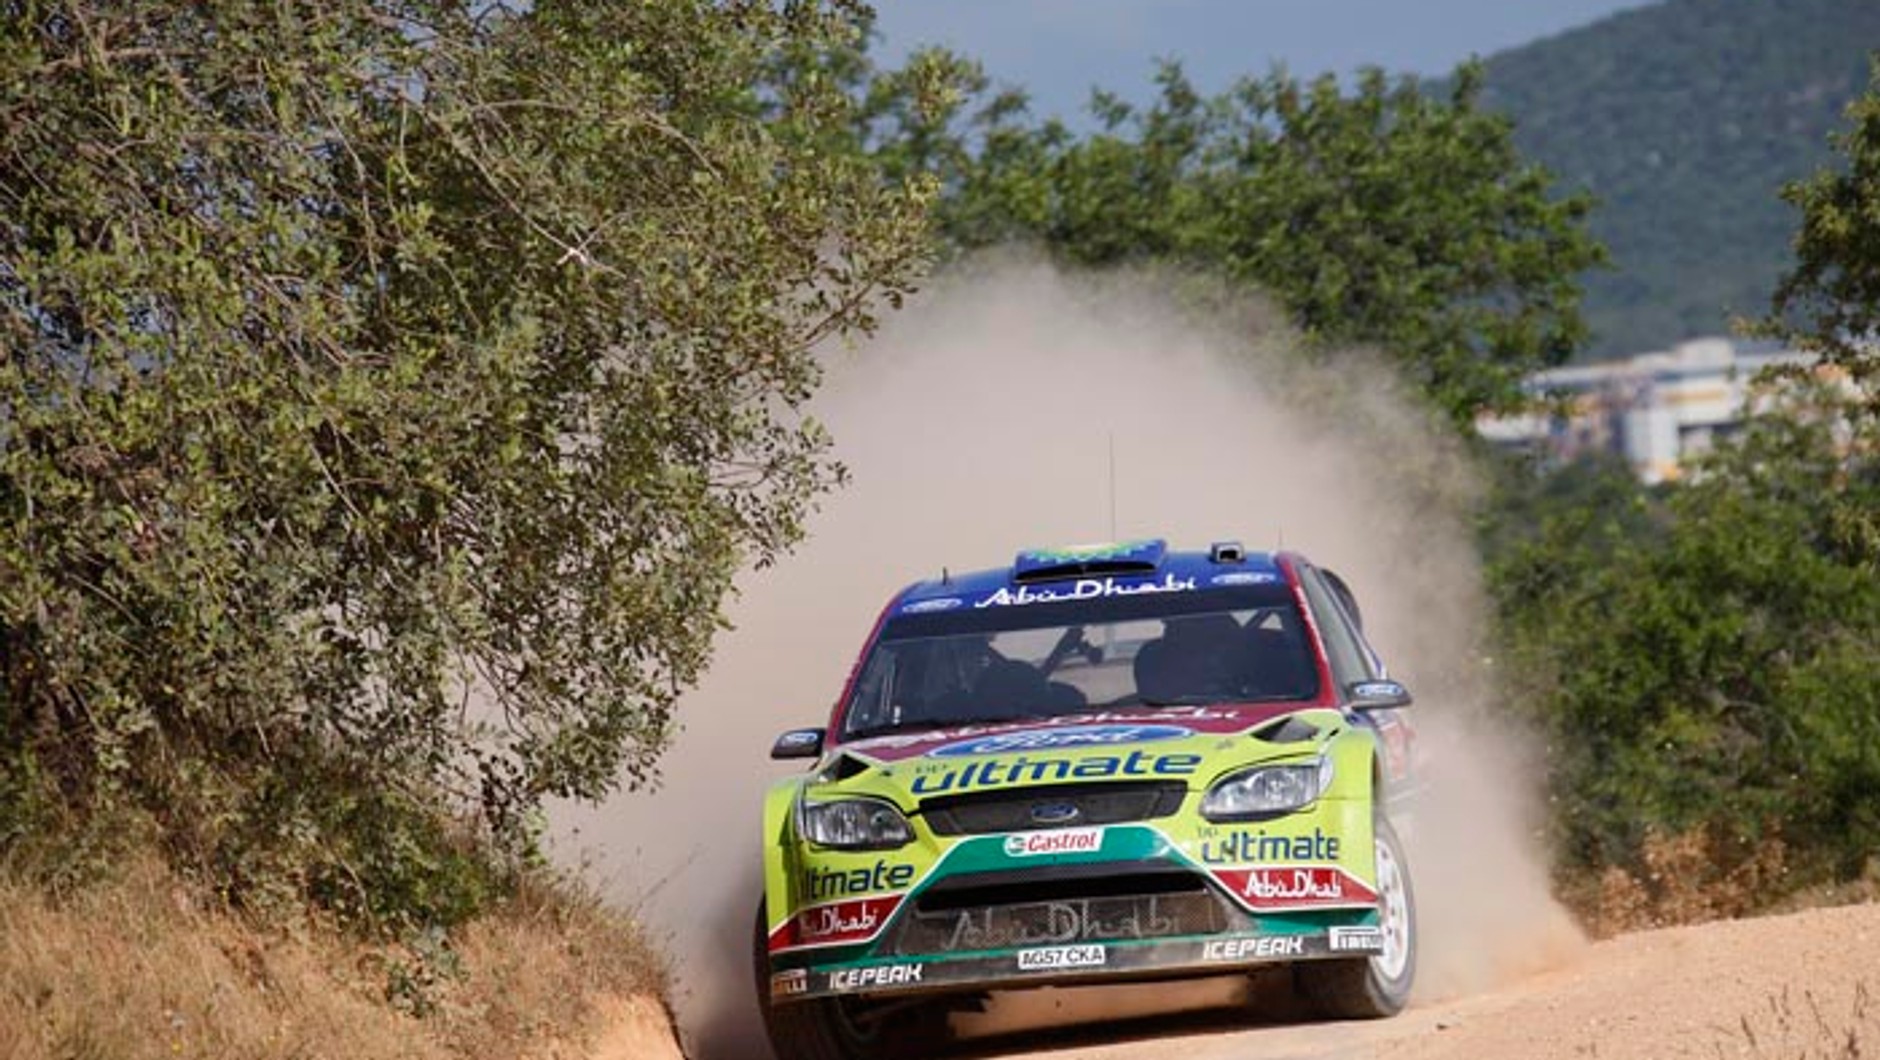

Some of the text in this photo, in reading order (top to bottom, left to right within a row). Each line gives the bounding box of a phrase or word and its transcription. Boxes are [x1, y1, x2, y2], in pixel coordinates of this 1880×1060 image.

[974, 587, 1061, 608] Abu
[1072, 573, 1195, 599] Dhabi
[1028, 832, 1097, 852] Castrol
[805, 860, 914, 899] ltimate
[1066, 946, 1103, 963] CKA
[1203, 936, 1304, 960] ICEPEAK
[829, 963, 923, 990] ICEPEAK
